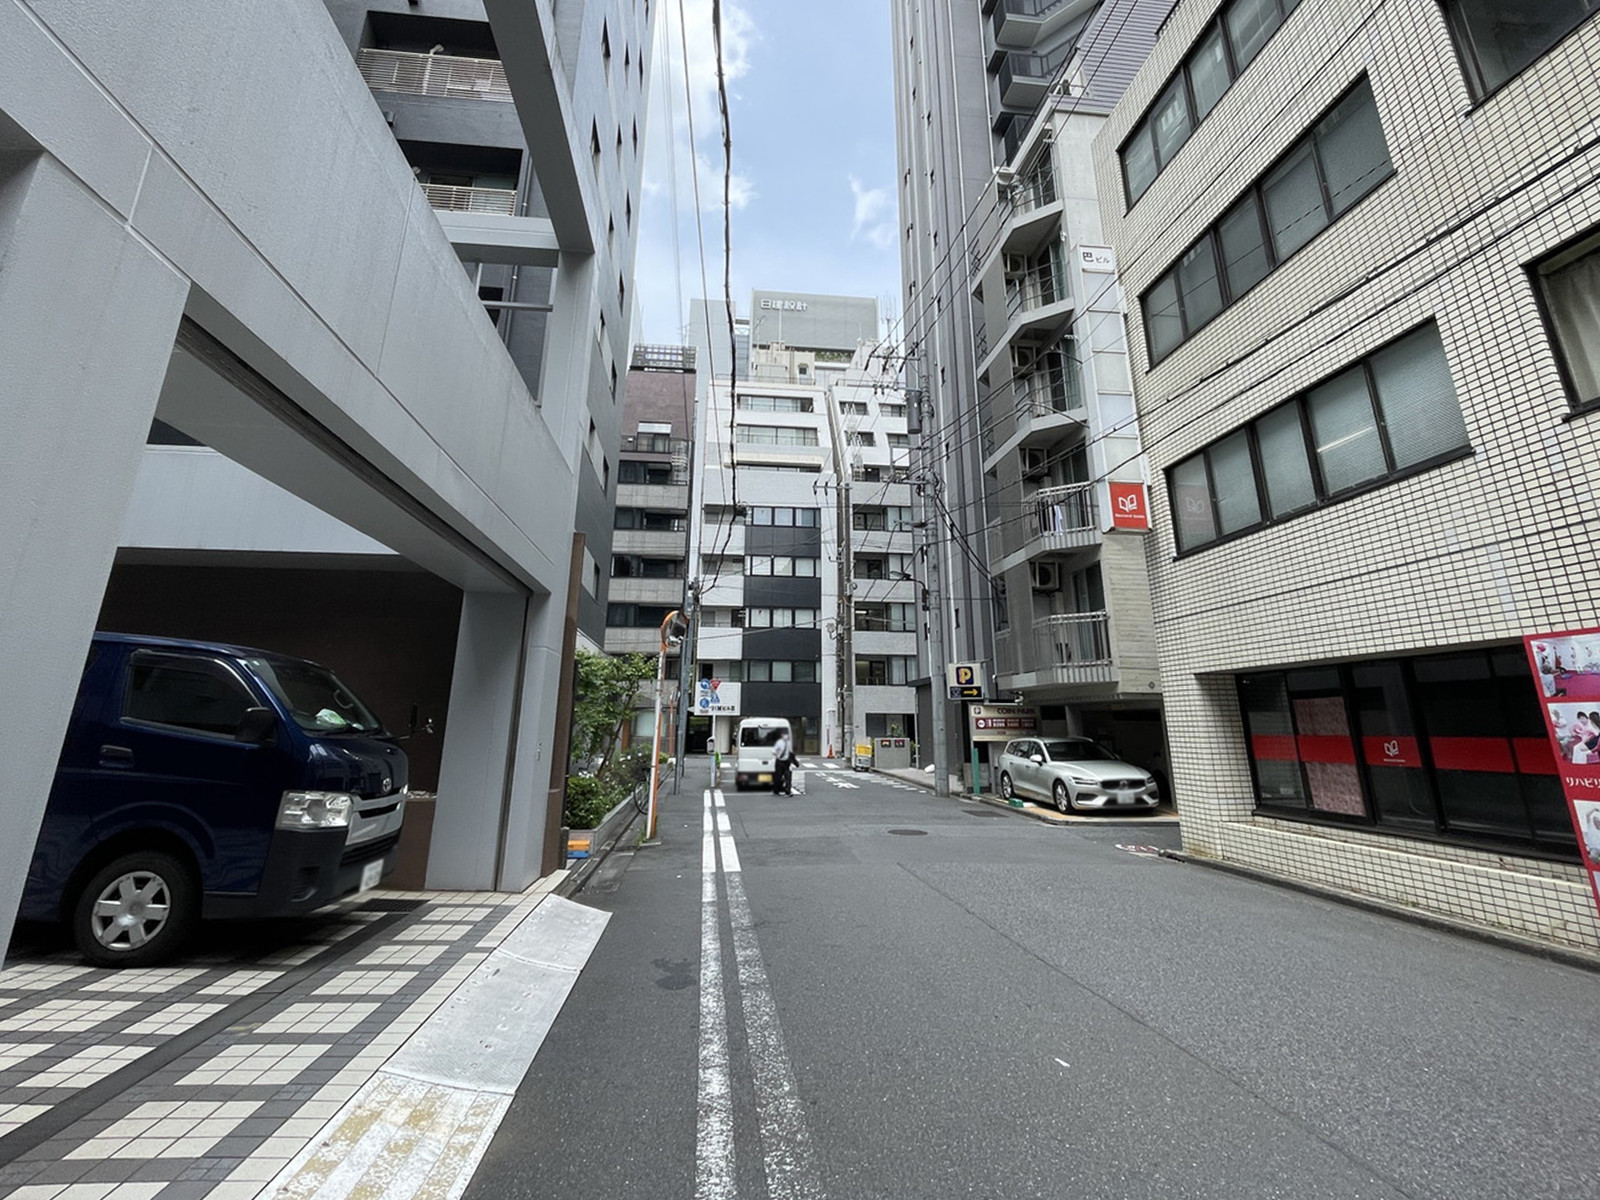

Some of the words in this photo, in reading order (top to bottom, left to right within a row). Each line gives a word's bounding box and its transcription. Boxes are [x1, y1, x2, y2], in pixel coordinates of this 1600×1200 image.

[1082, 251, 1110, 263] 巴ビル
[958, 667, 971, 684] P
